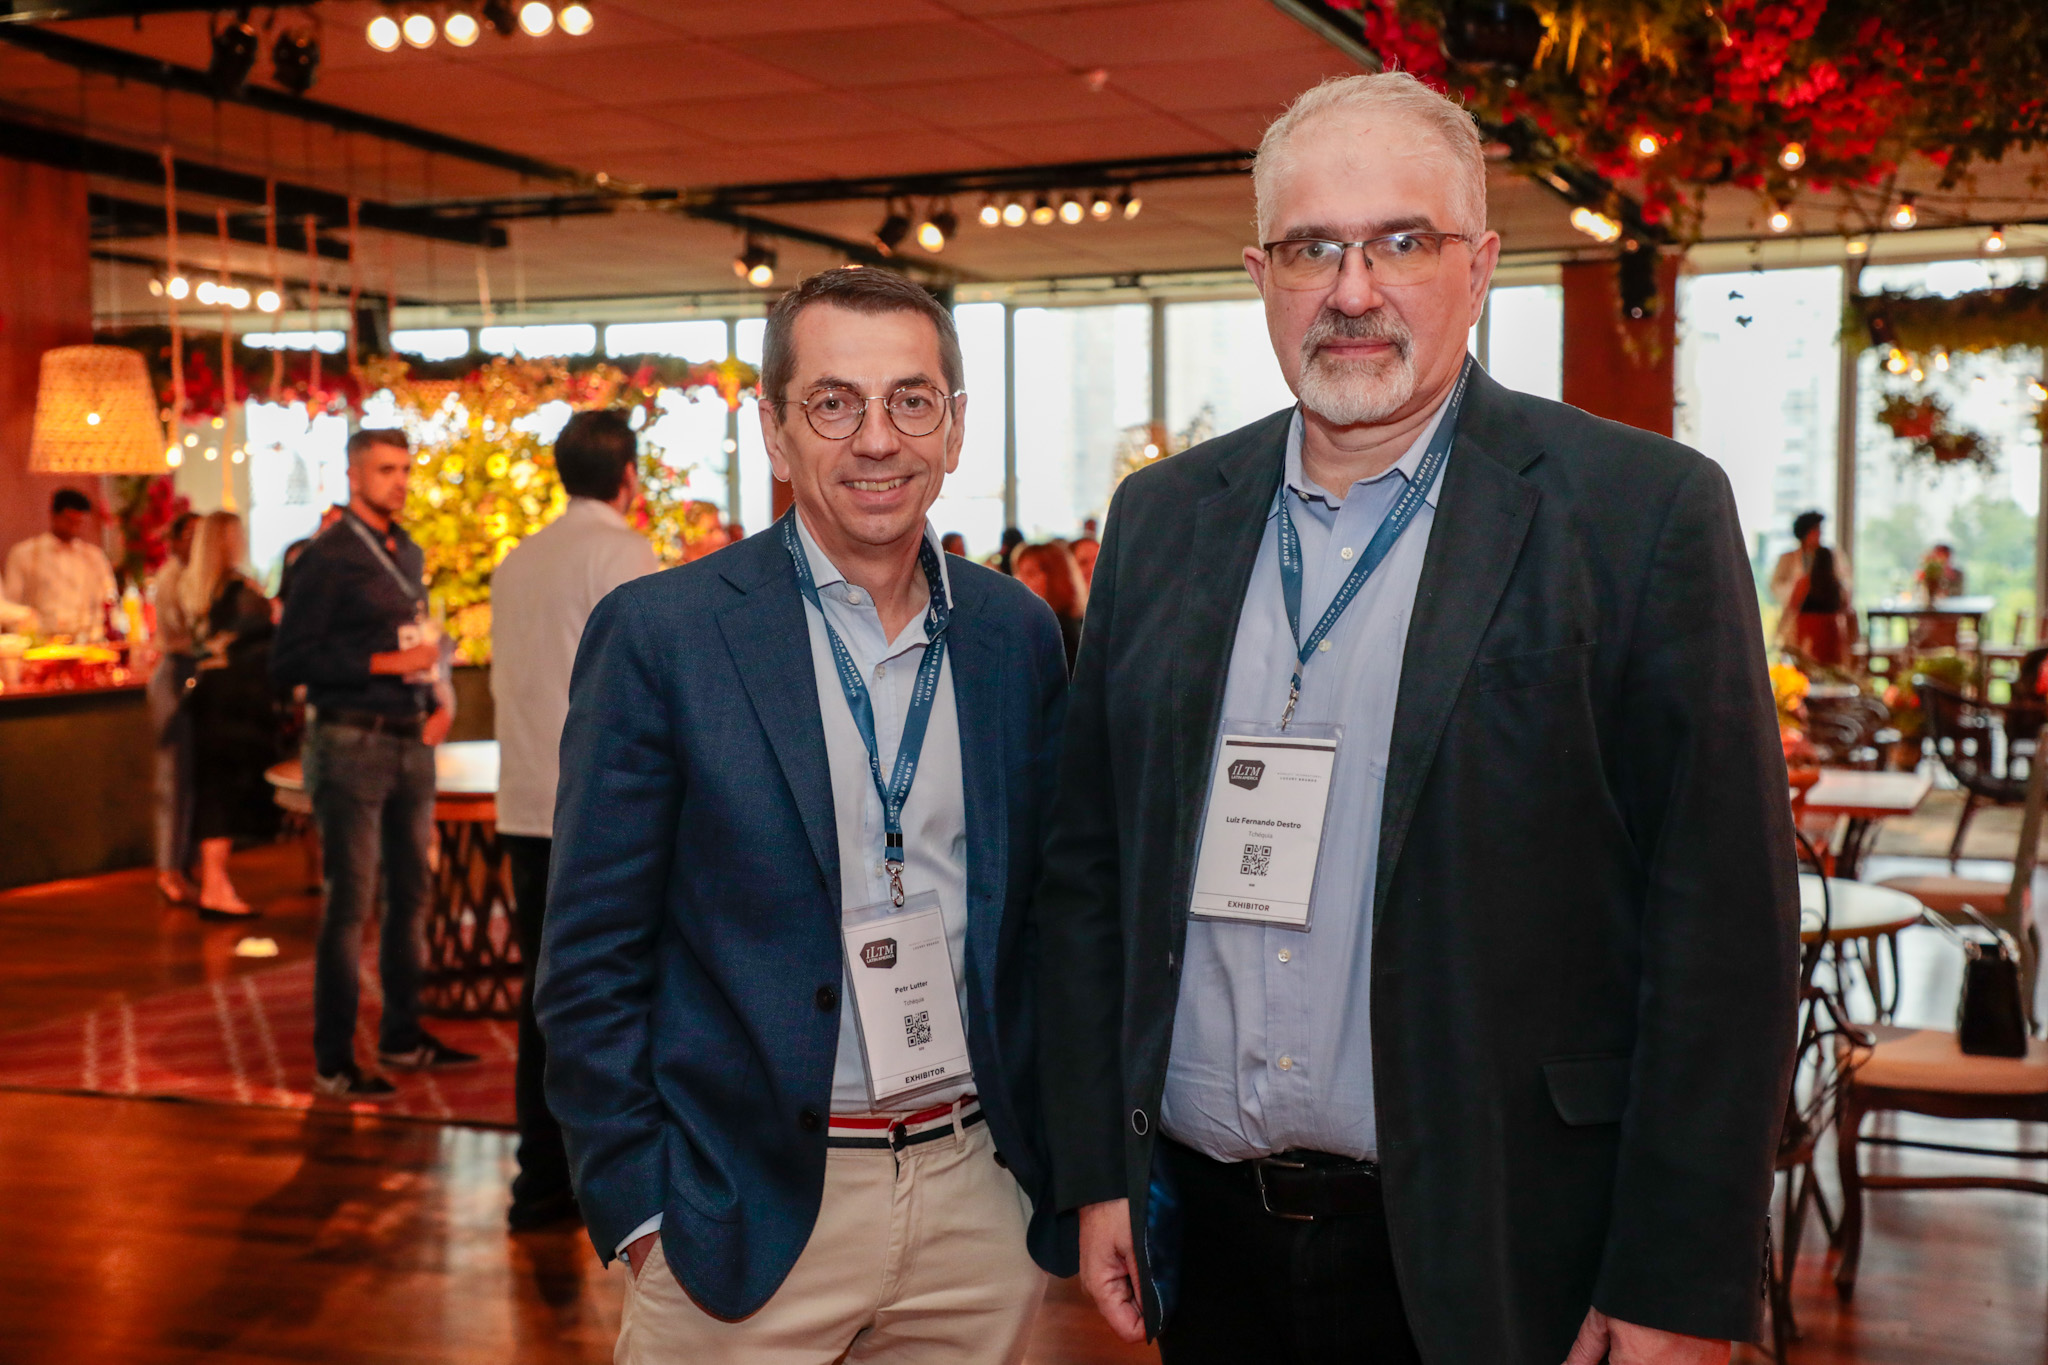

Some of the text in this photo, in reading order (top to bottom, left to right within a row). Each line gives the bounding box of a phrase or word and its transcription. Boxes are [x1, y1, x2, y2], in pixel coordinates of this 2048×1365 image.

[1390, 453, 1433, 522] LUXURY BRANDS
[1392, 452, 1442, 534] MARRIOTT INTERNATIONAL
[1282, 532, 1290, 567] BRANDS
[1310, 572, 1359, 641] LUXURY BRANDS
[841, 666, 857, 697] MARRIOTT
[844, 656, 862, 687] LUXURY
[924, 668, 936, 701] LUXURY
[914, 675, 925, 707] MARRIOTT
[899, 762, 913, 797] BRANDS
[1241, 817, 1275, 826] Fernando
[1276, 820, 1301, 829] Destro
[1227, 900, 1270, 911] EXHIBITOR
[895, 981, 928, 994] Petr Lutter
[905, 1066, 945, 1084] EXHIBITOR
